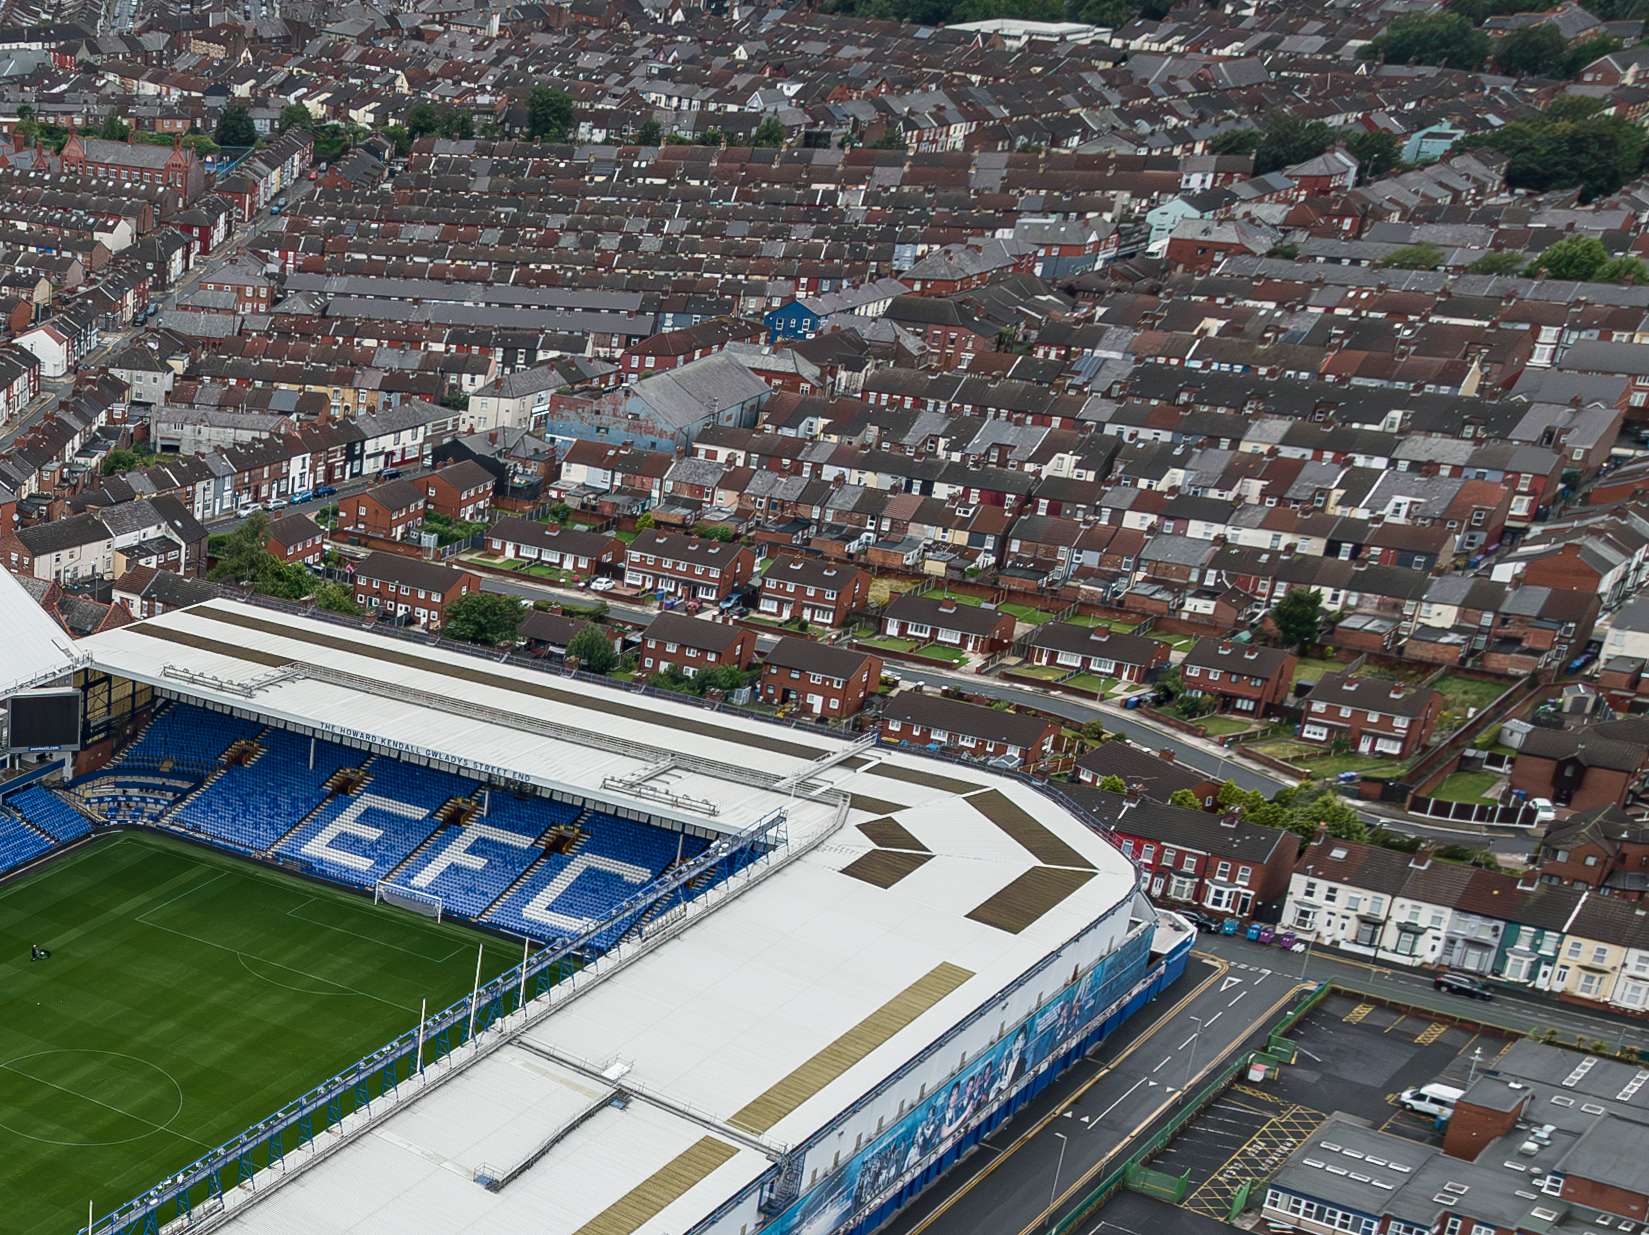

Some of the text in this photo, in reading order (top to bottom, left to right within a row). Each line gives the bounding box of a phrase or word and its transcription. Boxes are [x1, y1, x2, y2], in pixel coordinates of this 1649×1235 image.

[321, 721, 531, 782] THE HOWARD KENDALL GWLADYS STREET END
[301, 793, 652, 933] EFC
